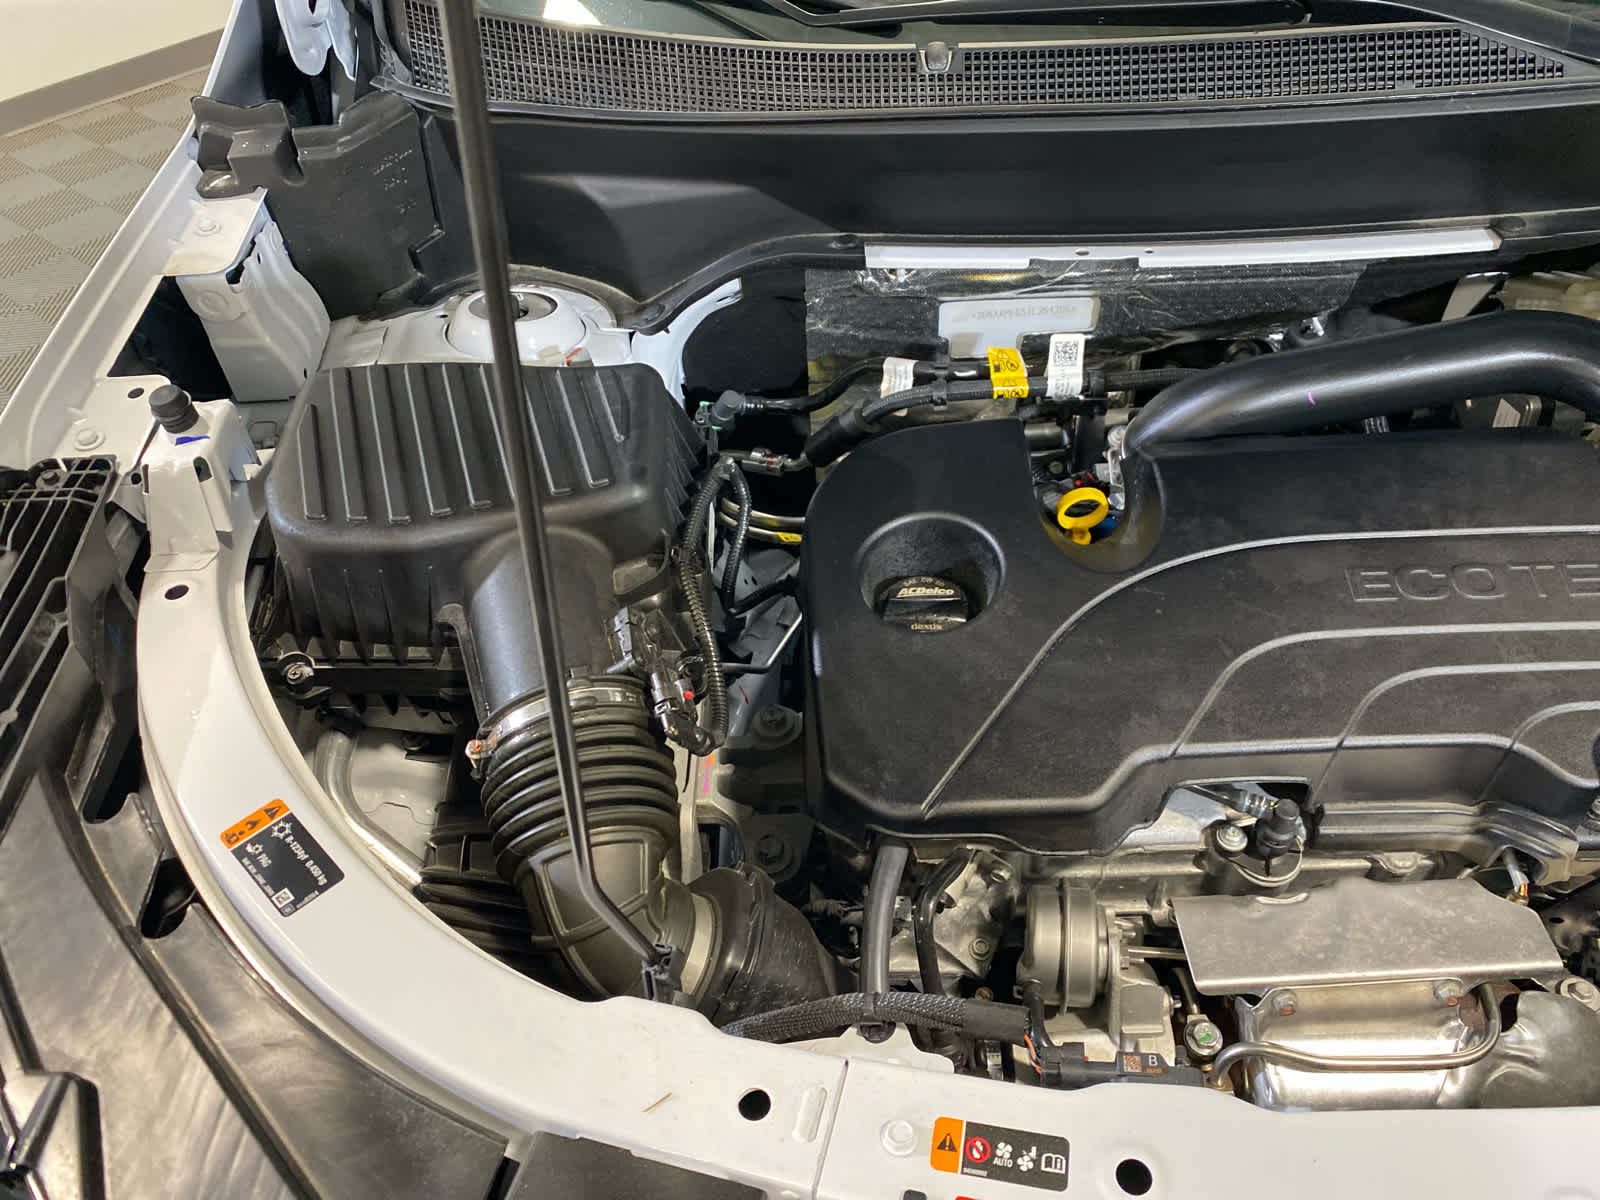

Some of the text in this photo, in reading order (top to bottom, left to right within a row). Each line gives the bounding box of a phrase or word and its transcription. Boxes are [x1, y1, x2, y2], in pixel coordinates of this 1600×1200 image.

[896, 587, 954, 597] ACDelco
[256, 852, 272, 868] PAG
[1149, 1055, 1158, 1066] B
[993, 1157, 1013, 1168] AUTO
